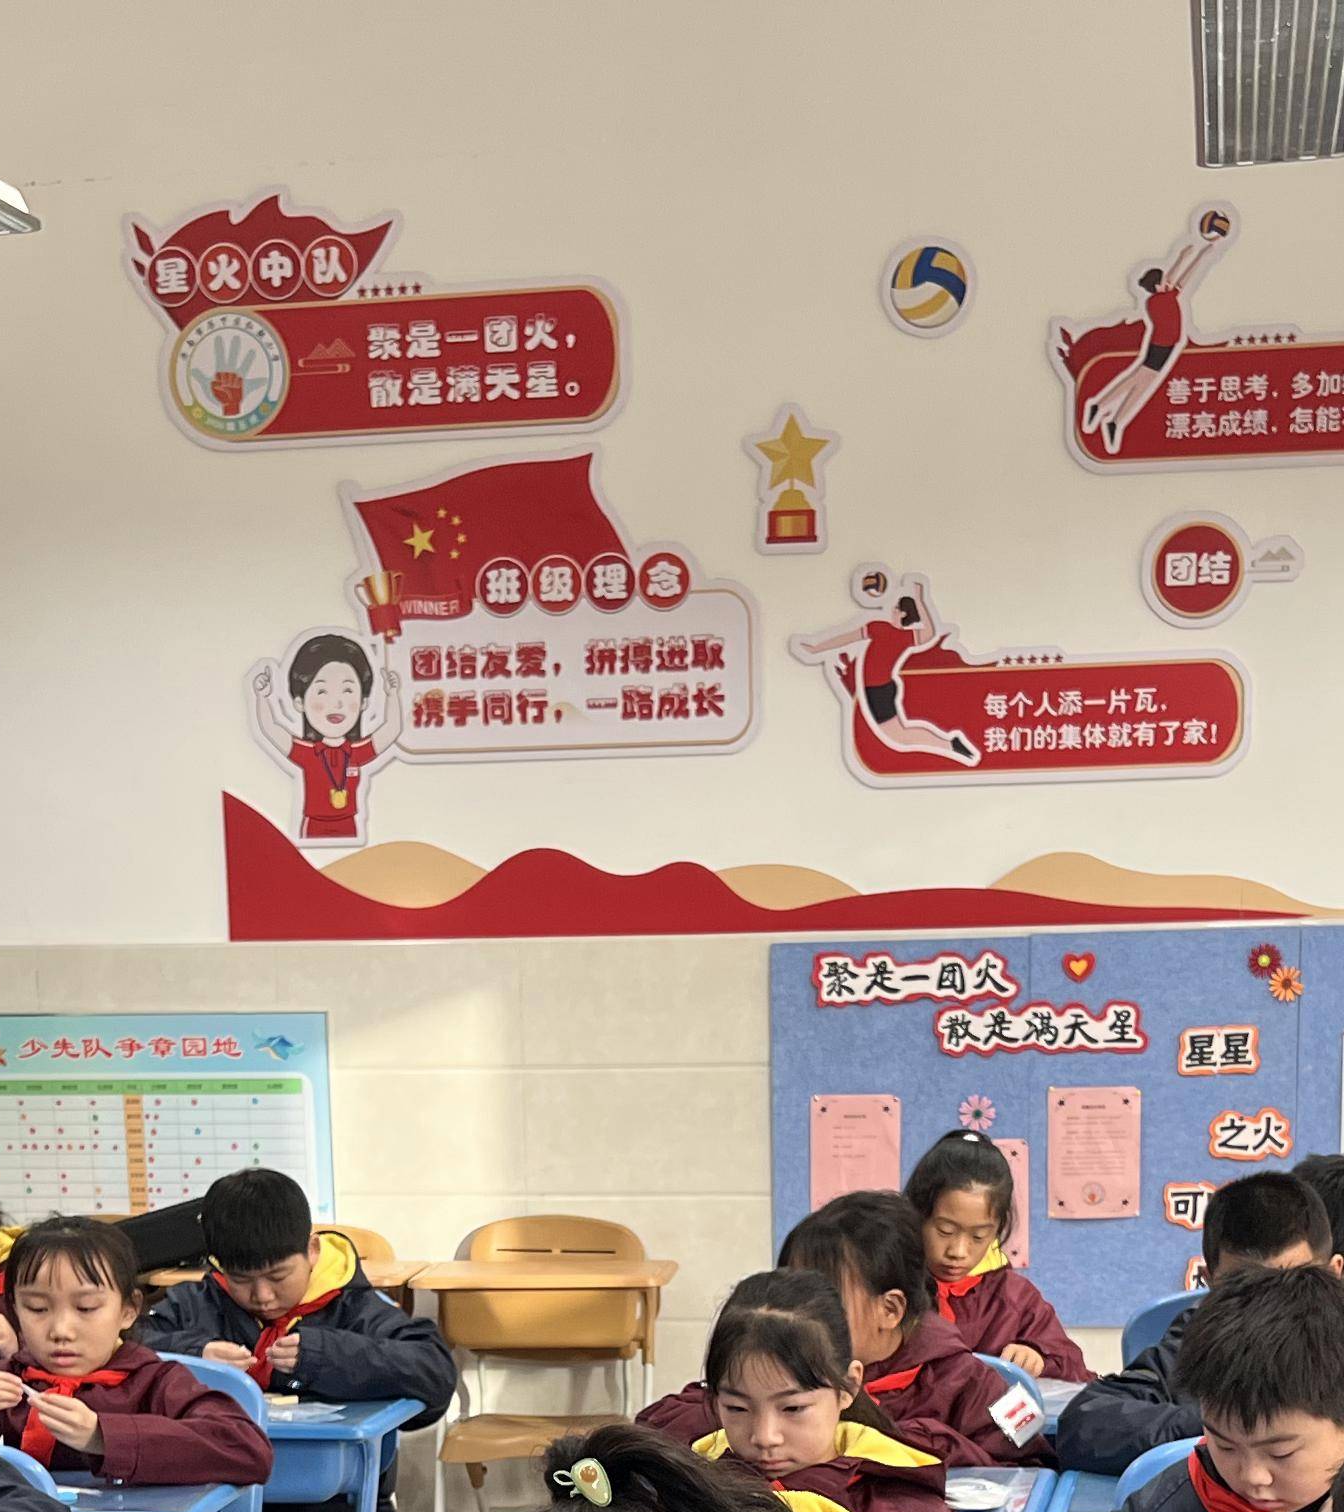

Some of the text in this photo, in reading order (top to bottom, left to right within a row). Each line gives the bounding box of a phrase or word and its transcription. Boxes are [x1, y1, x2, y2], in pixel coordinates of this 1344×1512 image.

[155, 246, 348, 295] 星火中队
[485, 560, 683, 604] 班级理念
[1165, 550, 1232, 587] 团结
[400, 599, 460, 616] WINNER
[983, 719, 1218, 753] 我们的集体就有了家！
[823, 957, 1013, 998] 聚是一团火
[941, 1005, 1141, 1048] 散是满天星
[18, 1036, 243, 1060] 少先队争章园地
[1185, 1030, 1253, 1070] 星星
[1216, 1115, 1287, 1152] 之火
